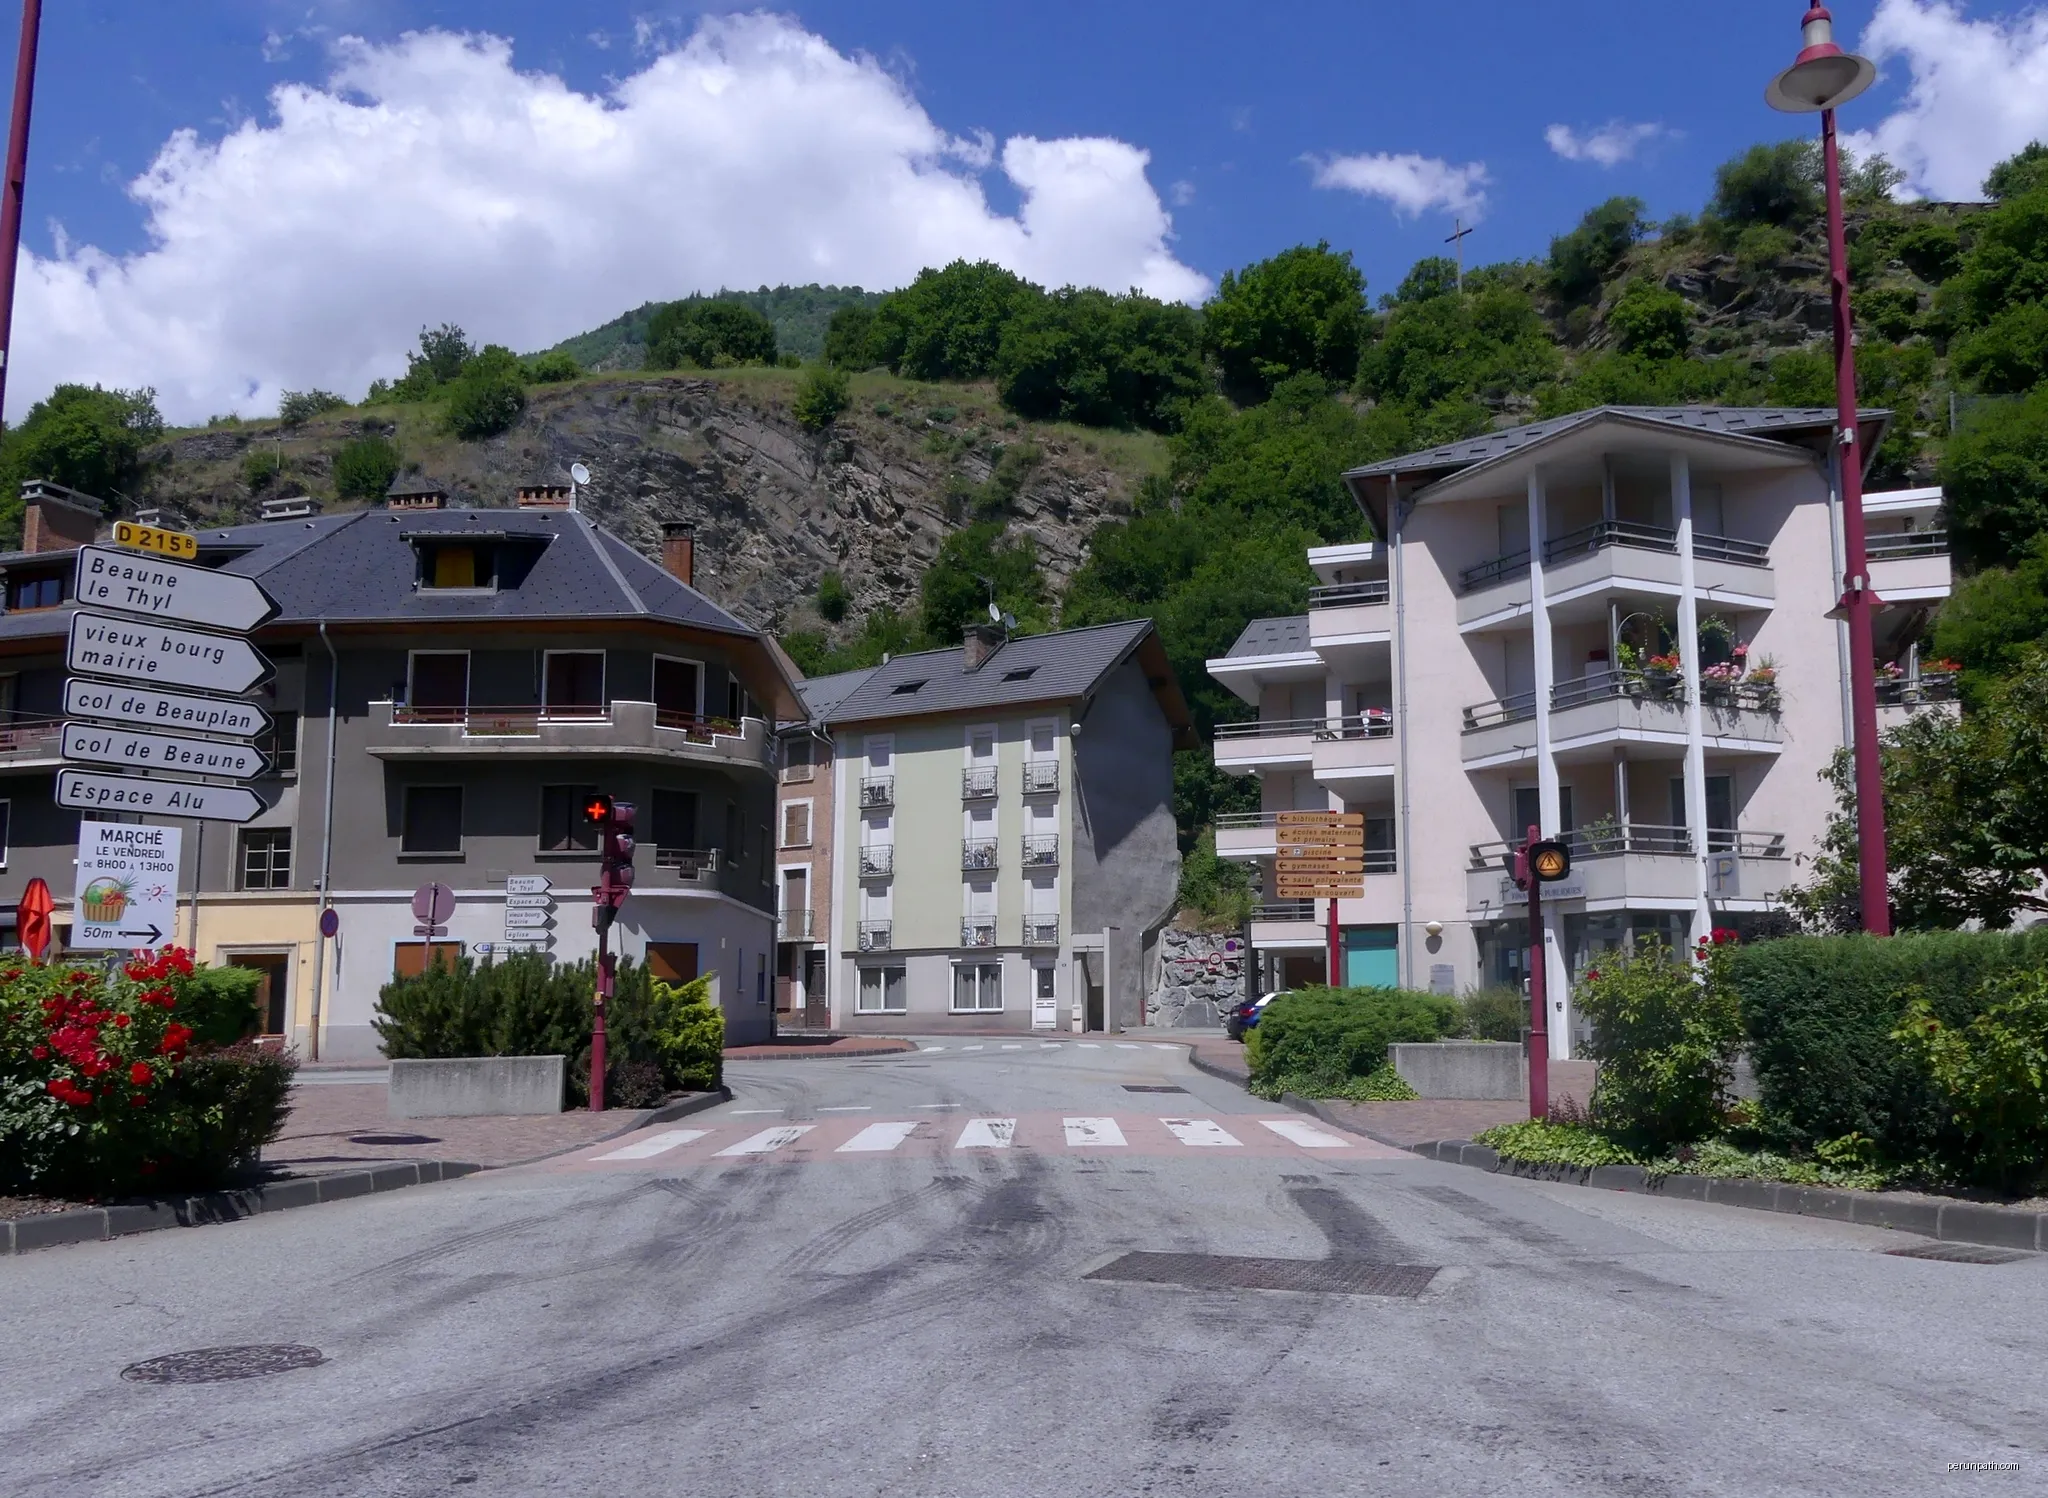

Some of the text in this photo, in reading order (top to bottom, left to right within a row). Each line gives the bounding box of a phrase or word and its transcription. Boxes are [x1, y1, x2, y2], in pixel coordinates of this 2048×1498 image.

[119, 525, 131, 542] D
[90, 557, 178, 588] Beaune
[88, 580, 172, 610] le Thyl
[86, 625, 225, 664] vieux bourg
[81, 650, 158, 673] mairie
[78, 693, 251, 728] col de Beauplan
[74, 737, 246, 769] col de Beaune
[69, 781, 204, 810] Espace Alu
[100, 828, 163, 845] MARCHÉ
[96, 846, 165, 859] LE VENDREDI
[1303, 849, 1332, 857] piscine
[97, 859, 126, 870] 8H00
[139, 861, 174, 872] 13H00
[1291, 862, 1330, 870] gymnases
[1315, 876, 1361, 885] polyvalente
[524, 911, 540, 919] bourg
[83, 927, 112, 939] 50m
[508, 931, 529, 939] église
